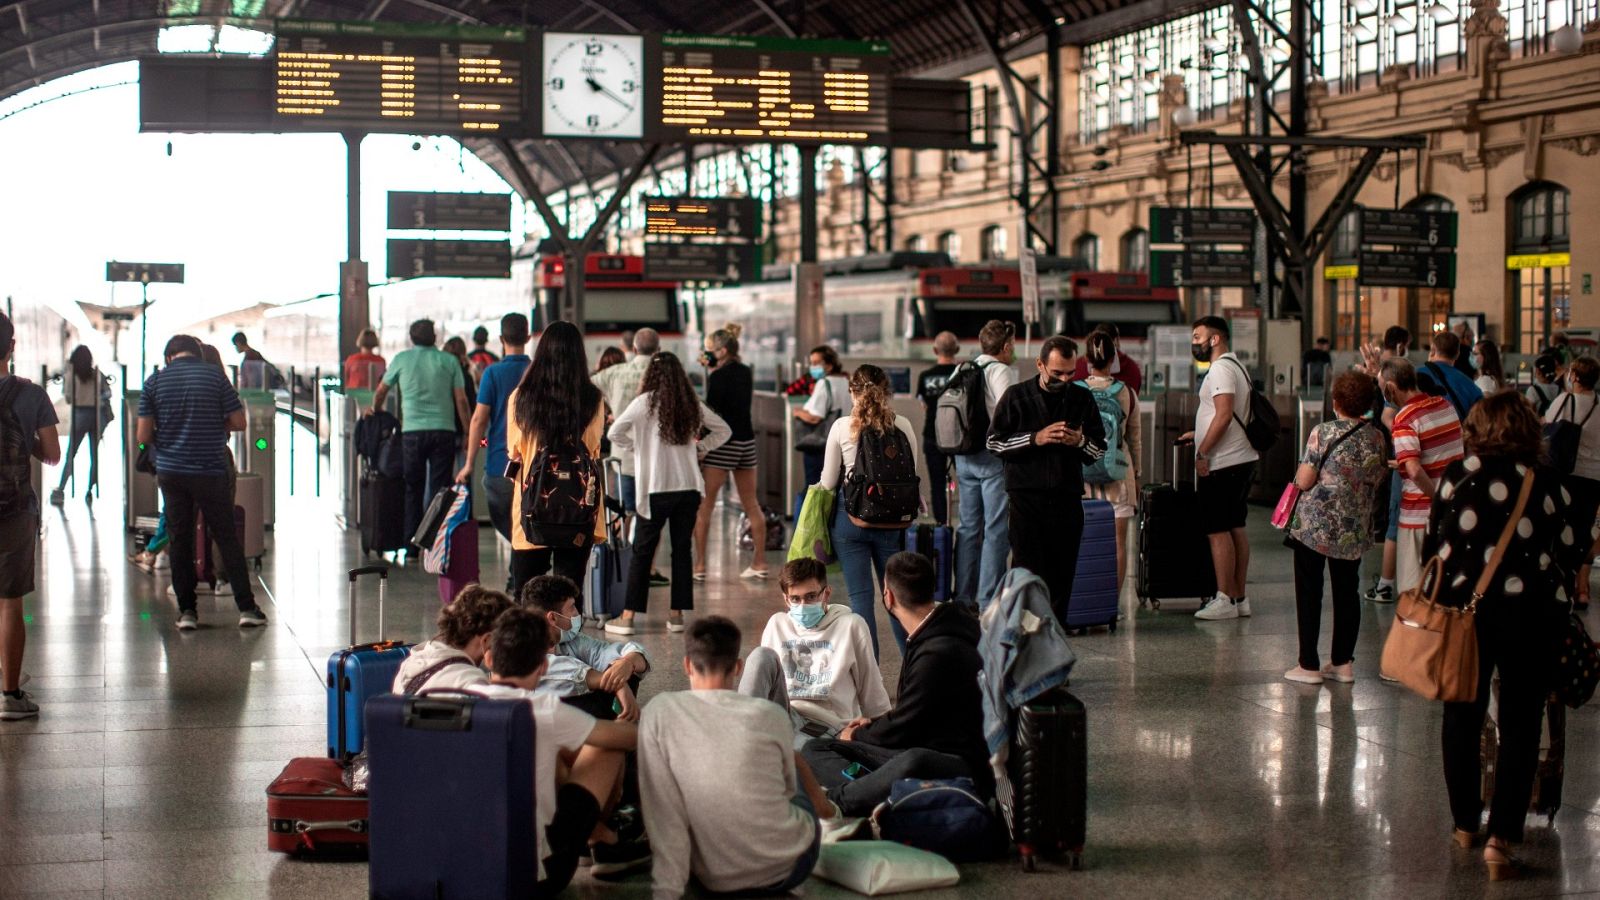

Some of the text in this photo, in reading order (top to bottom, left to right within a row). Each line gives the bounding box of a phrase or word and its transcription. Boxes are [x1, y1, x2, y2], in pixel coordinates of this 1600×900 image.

[585, 43, 603, 56] 12
[551, 78, 563, 90] 9
[622, 80, 635, 93] 3
[587, 115, 599, 128] 6
[1173, 226, 1183, 242] 5
[1429, 229, 1438, 245] 6
[1173, 268, 1183, 286] 5
[1428, 271, 1437, 286] 6
